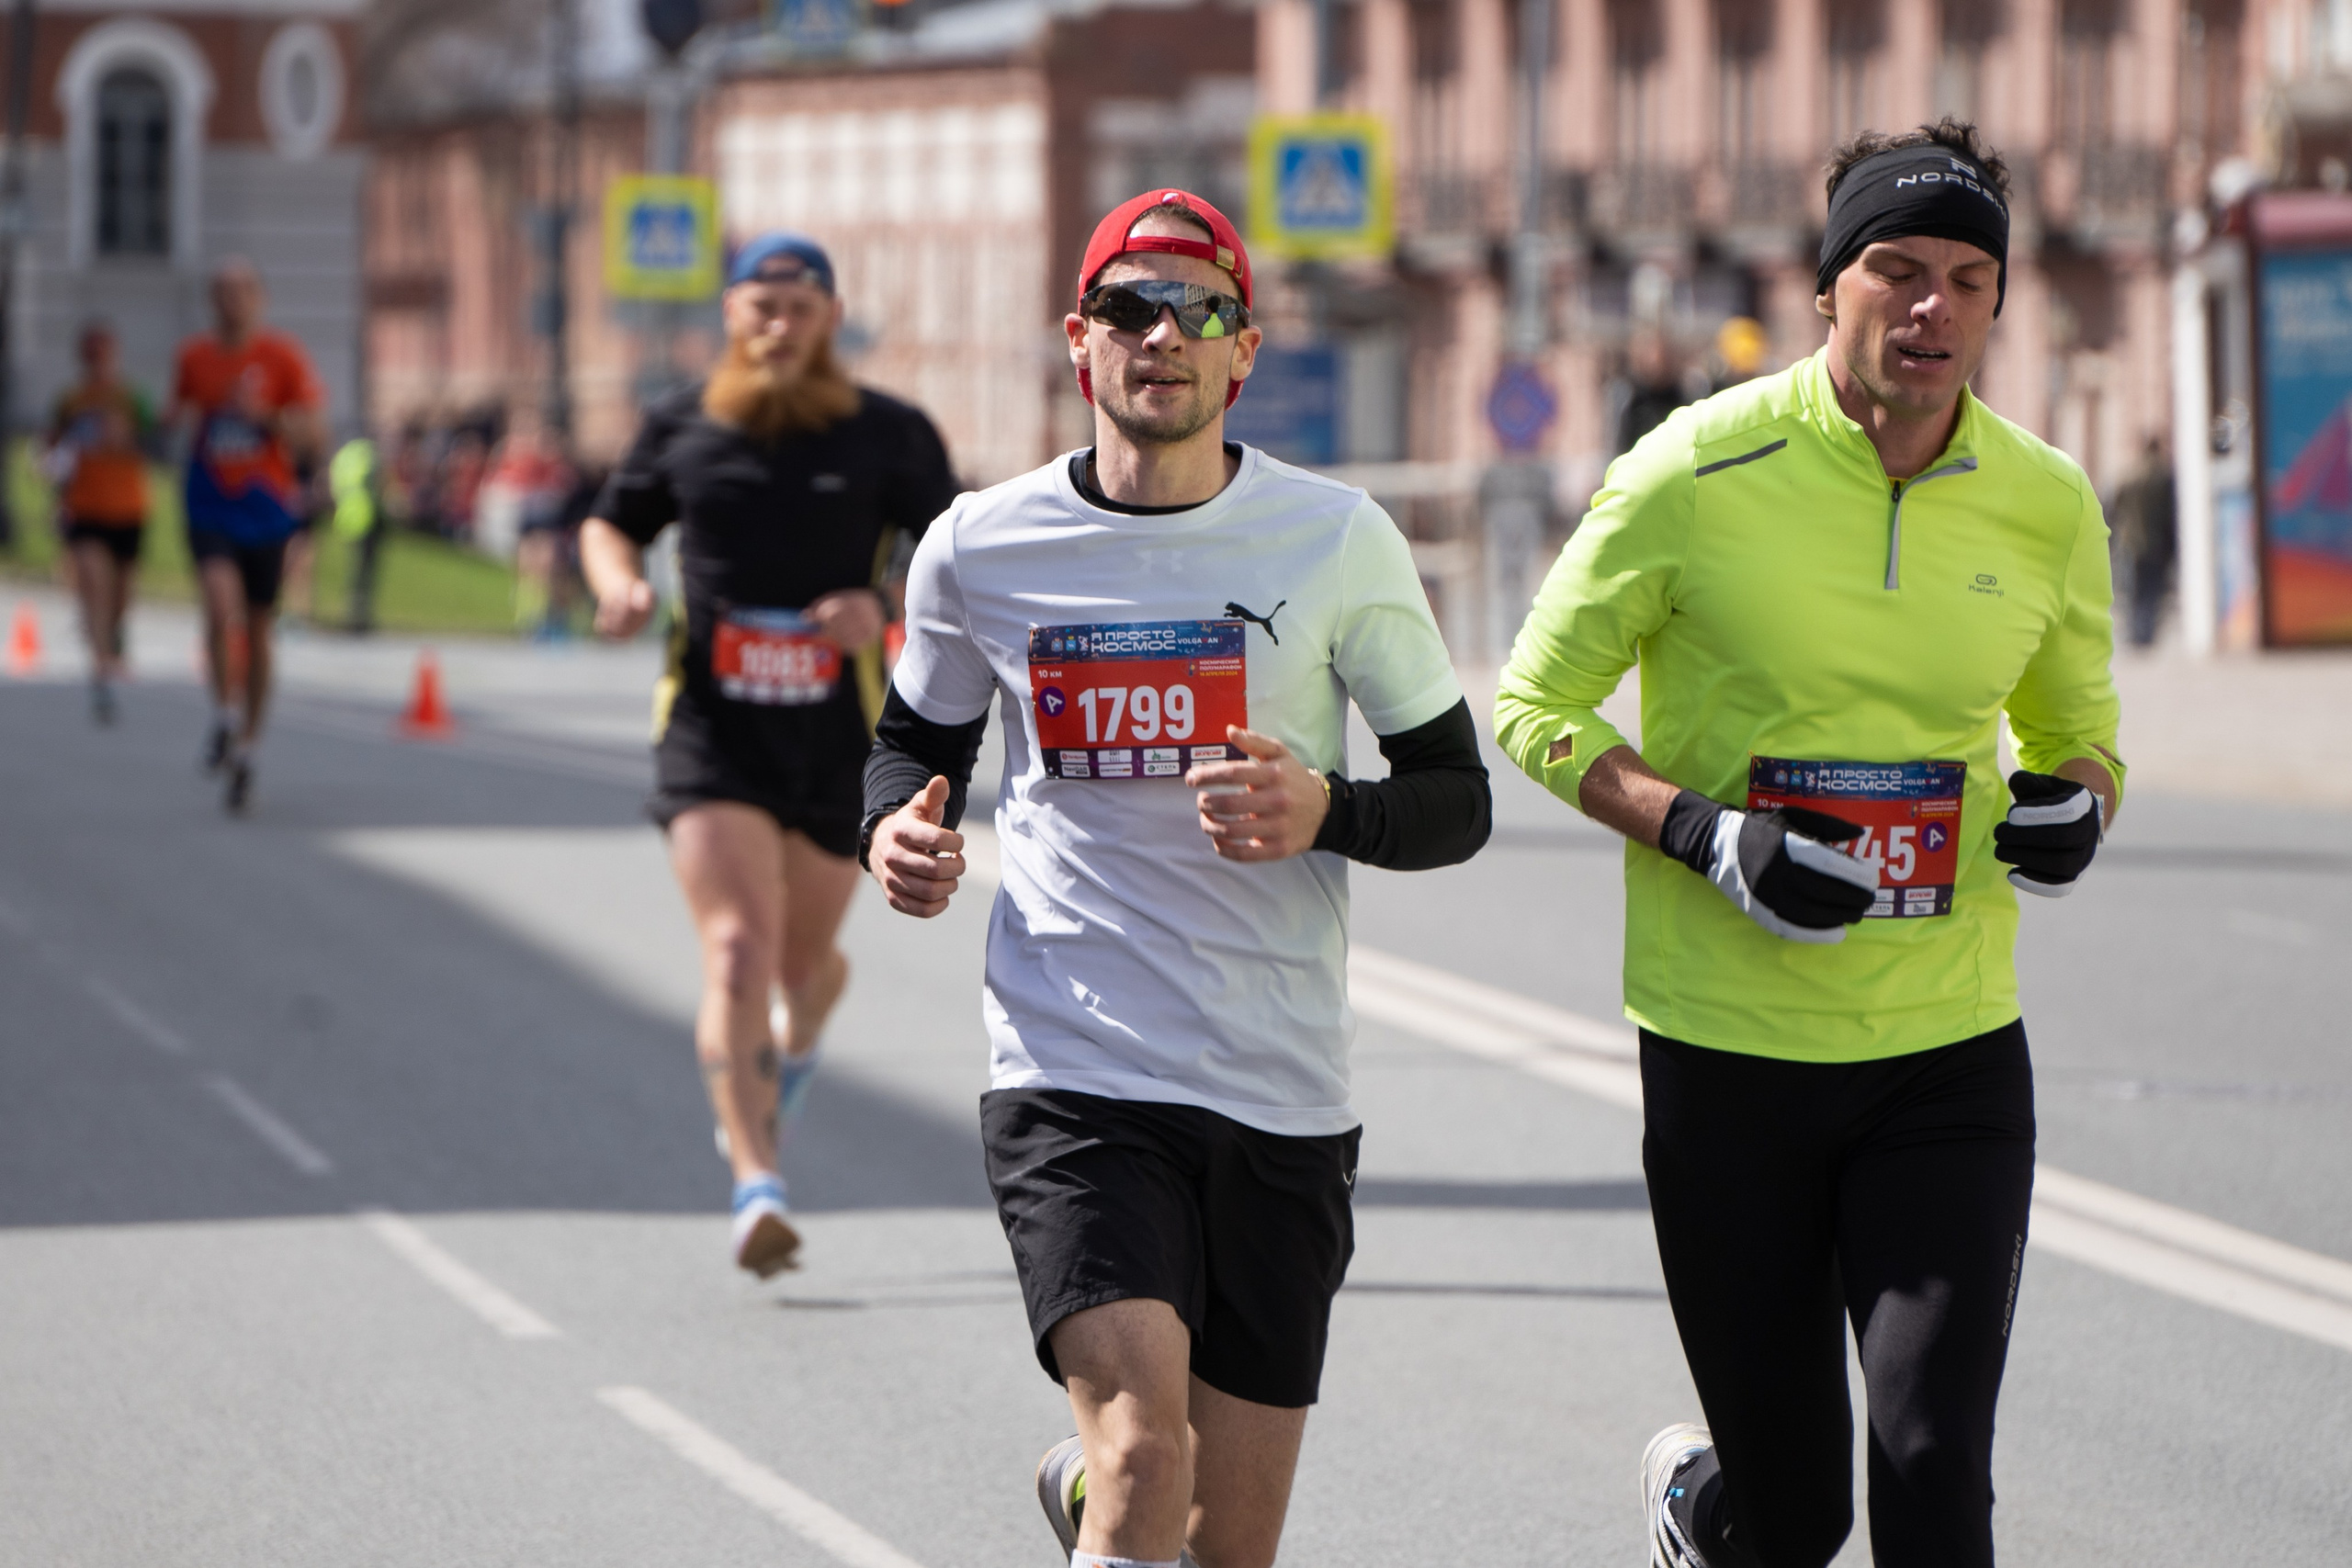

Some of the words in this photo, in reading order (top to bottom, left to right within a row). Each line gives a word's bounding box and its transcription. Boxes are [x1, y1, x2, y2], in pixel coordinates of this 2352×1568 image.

[1968, 584, 2005, 598] Kalenji
[1091, 632, 1102, 641] Я
[1104, 630, 1176, 641] ПРОСТО
[1091, 640, 1176, 652] КОСМОС
[1037, 670, 1048, 679] 10
[1078, 683, 1195, 743] 1799
[1818, 770, 1830, 779] Я
[1833, 770, 1903, 780] ПРОСТО
[1817, 779, 1902, 791] КОСМОС
[1831, 825, 1917, 881] 45
[2002, 1233, 2022, 1337] NORDSKI
